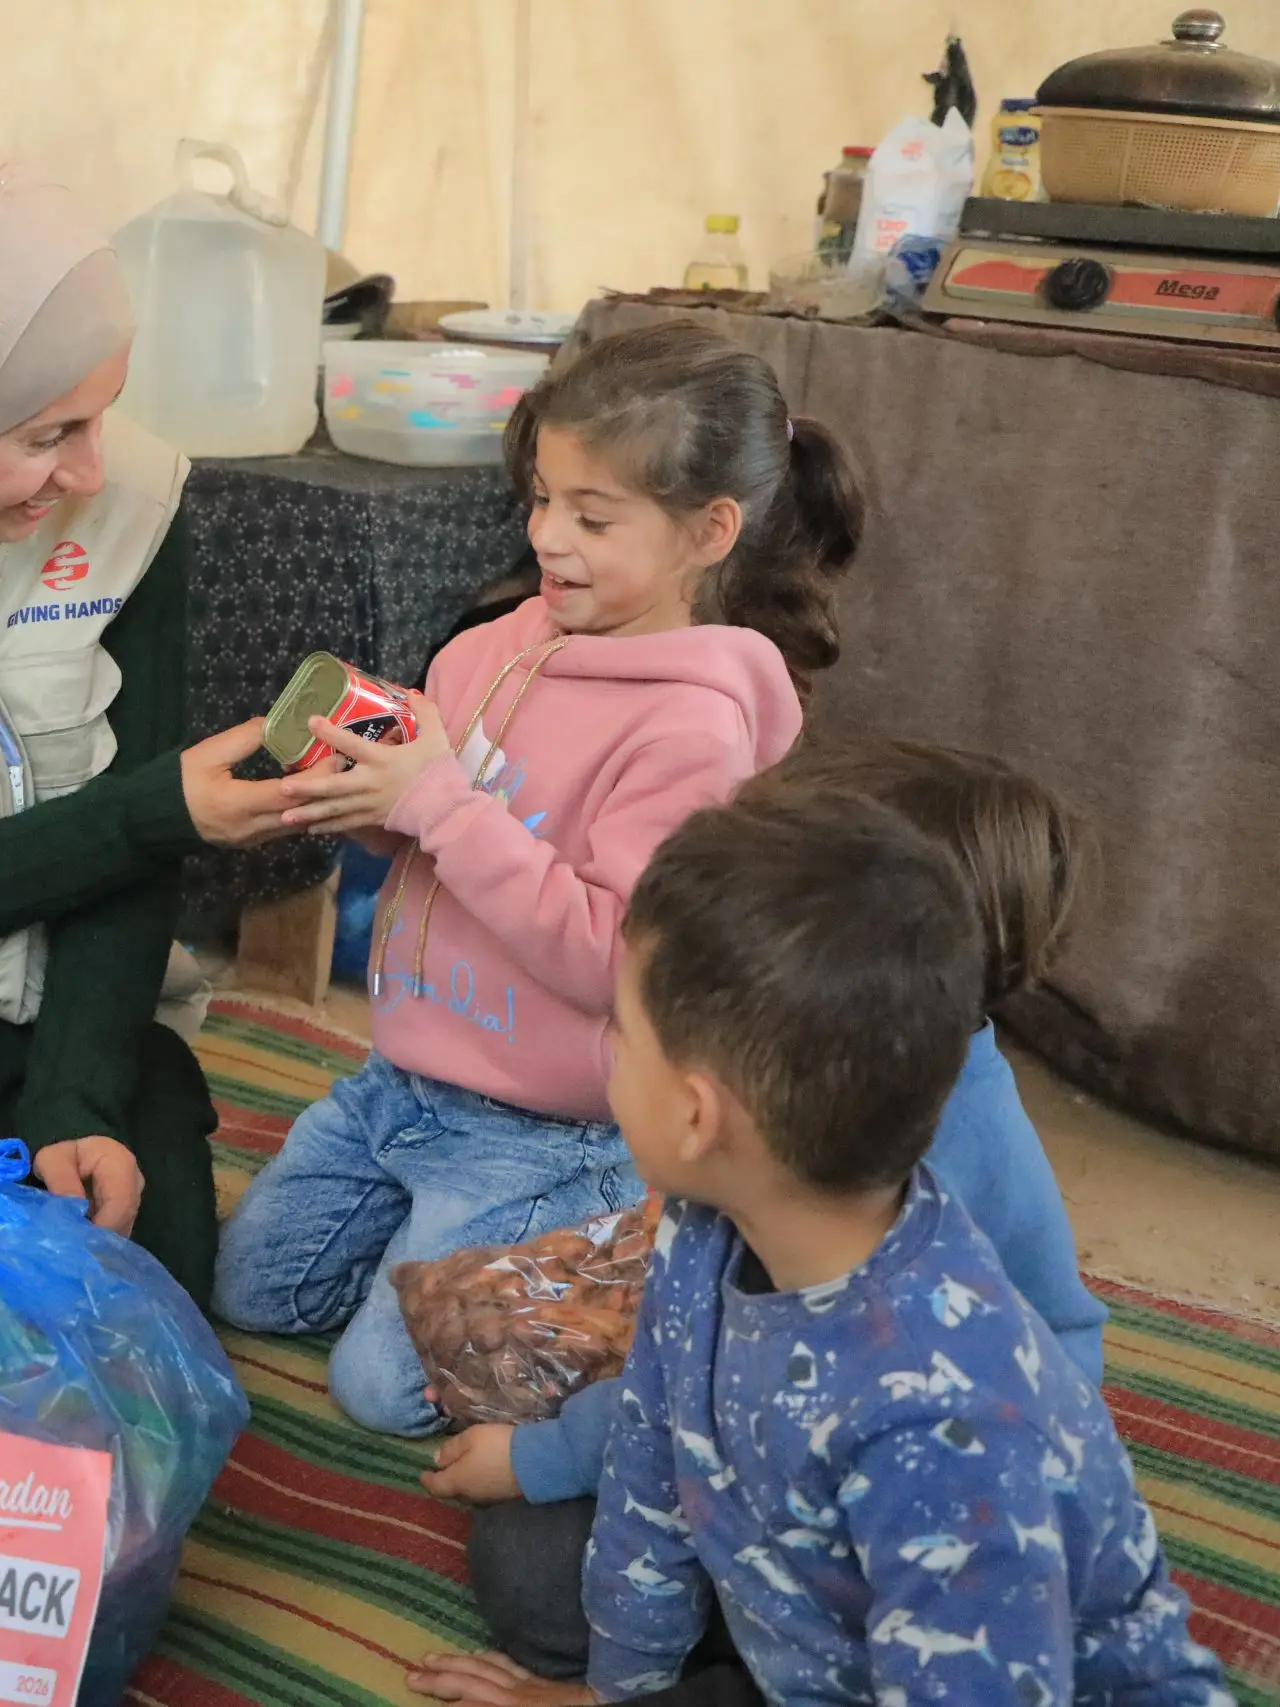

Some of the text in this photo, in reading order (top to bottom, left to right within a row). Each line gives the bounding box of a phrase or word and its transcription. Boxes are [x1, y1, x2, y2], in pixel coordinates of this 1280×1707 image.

[1155, 279, 1221, 300] Mega
[6, 597, 124, 629] GIVING HANDS
[14, 1674, 50, 1697] 2026
